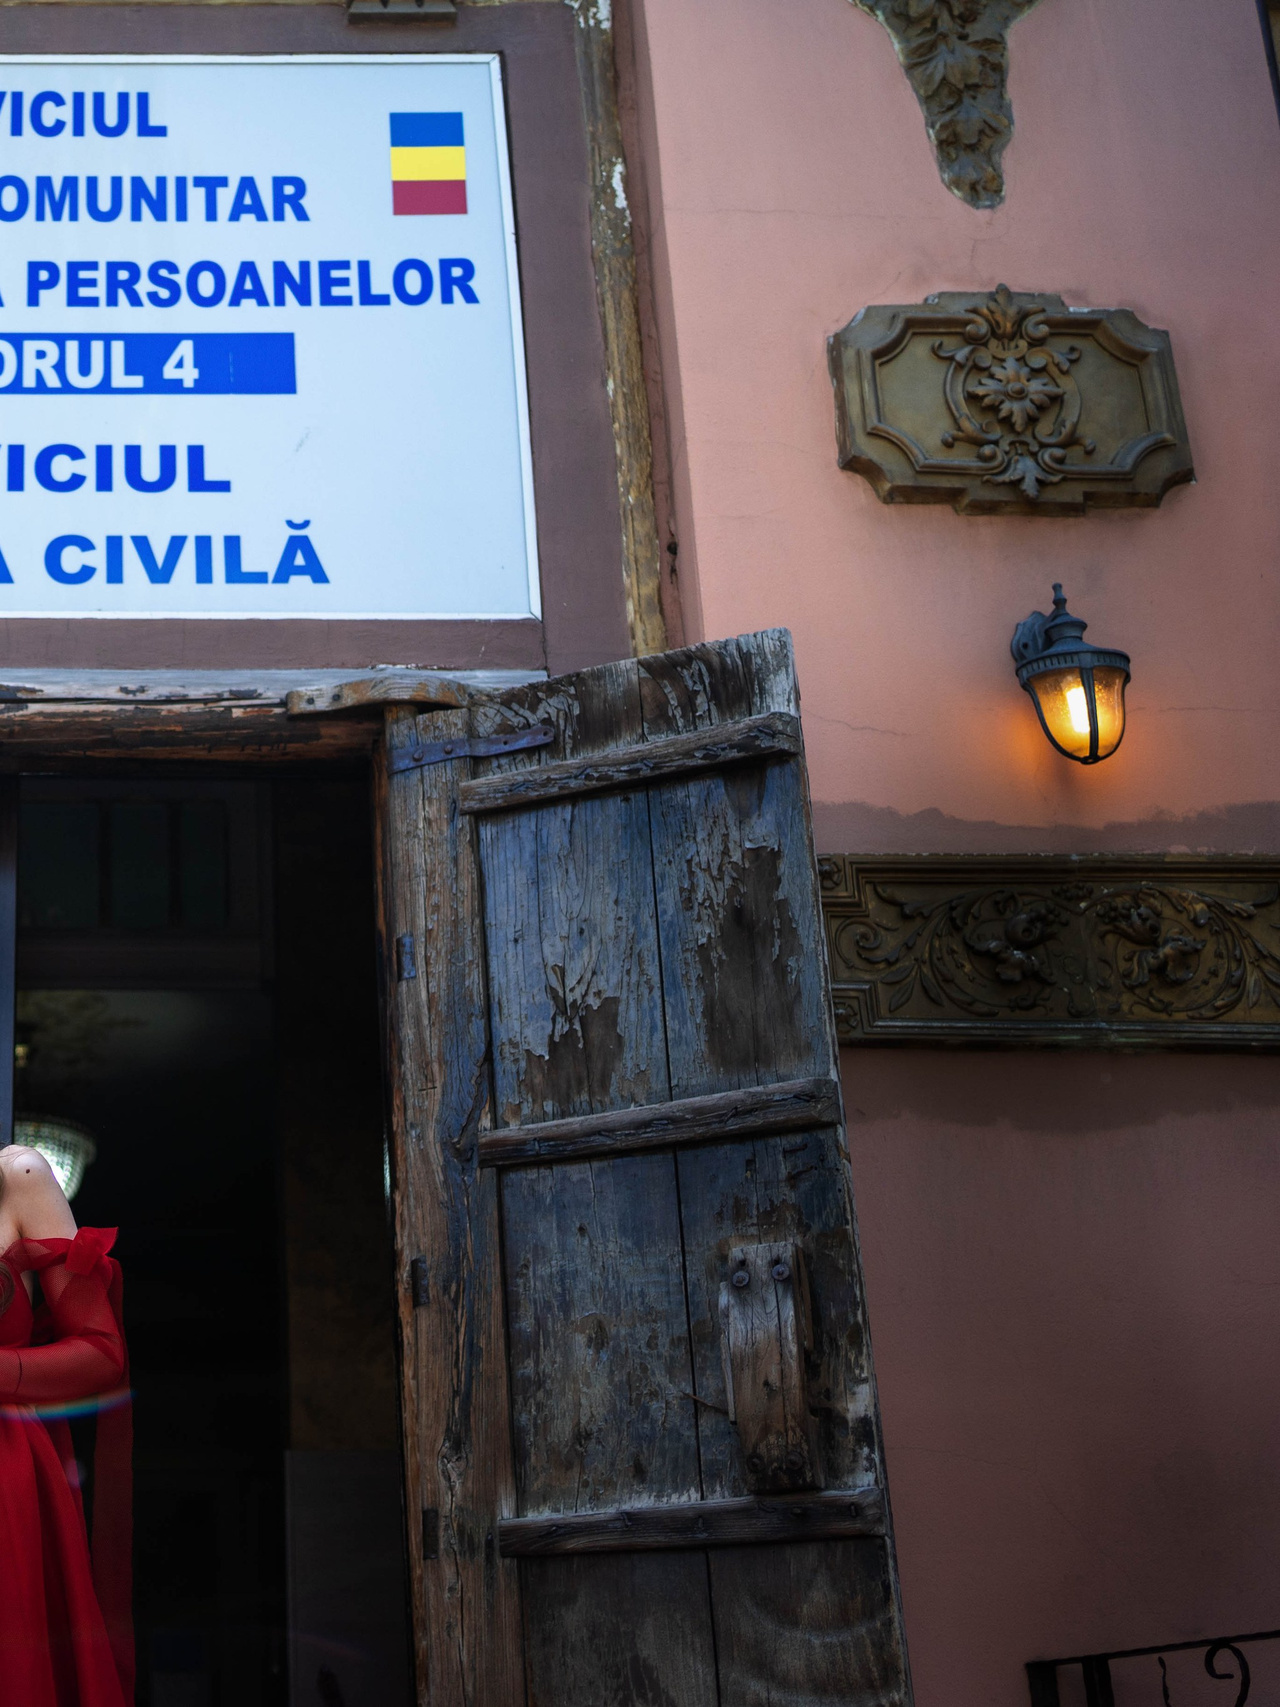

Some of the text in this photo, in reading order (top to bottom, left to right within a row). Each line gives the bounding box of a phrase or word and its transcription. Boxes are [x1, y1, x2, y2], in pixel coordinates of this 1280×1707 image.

[26, 256, 480, 308] PERSOANELOR
[162, 339, 200, 388] 4
[43, 519, 330, 585] CIVILĂ
